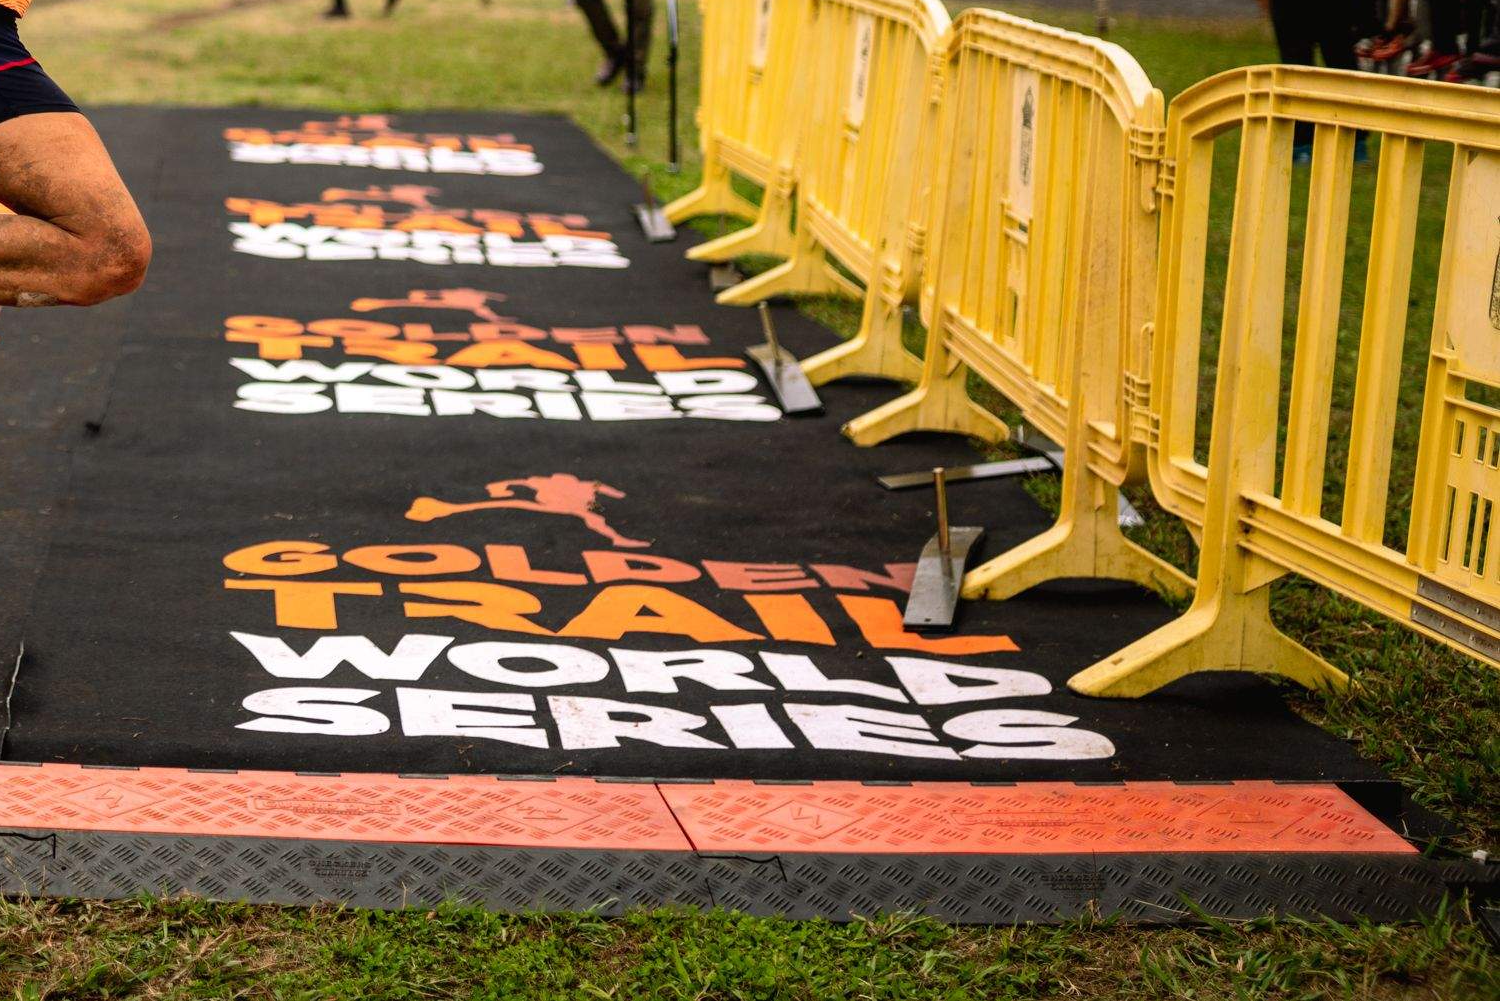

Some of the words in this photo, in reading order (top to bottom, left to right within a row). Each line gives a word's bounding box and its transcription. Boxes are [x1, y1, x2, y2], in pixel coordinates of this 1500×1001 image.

[224, 315, 710, 345] GOLDEN
[226, 329, 747, 371] TRAIL
[229, 357, 758, 395] WORLD
[233, 382, 782, 421] SERIES
[224, 578, 1021, 654] TRAIL
[230, 630, 1052, 705] WORLD
[234, 686, 1116, 761] SERIES
